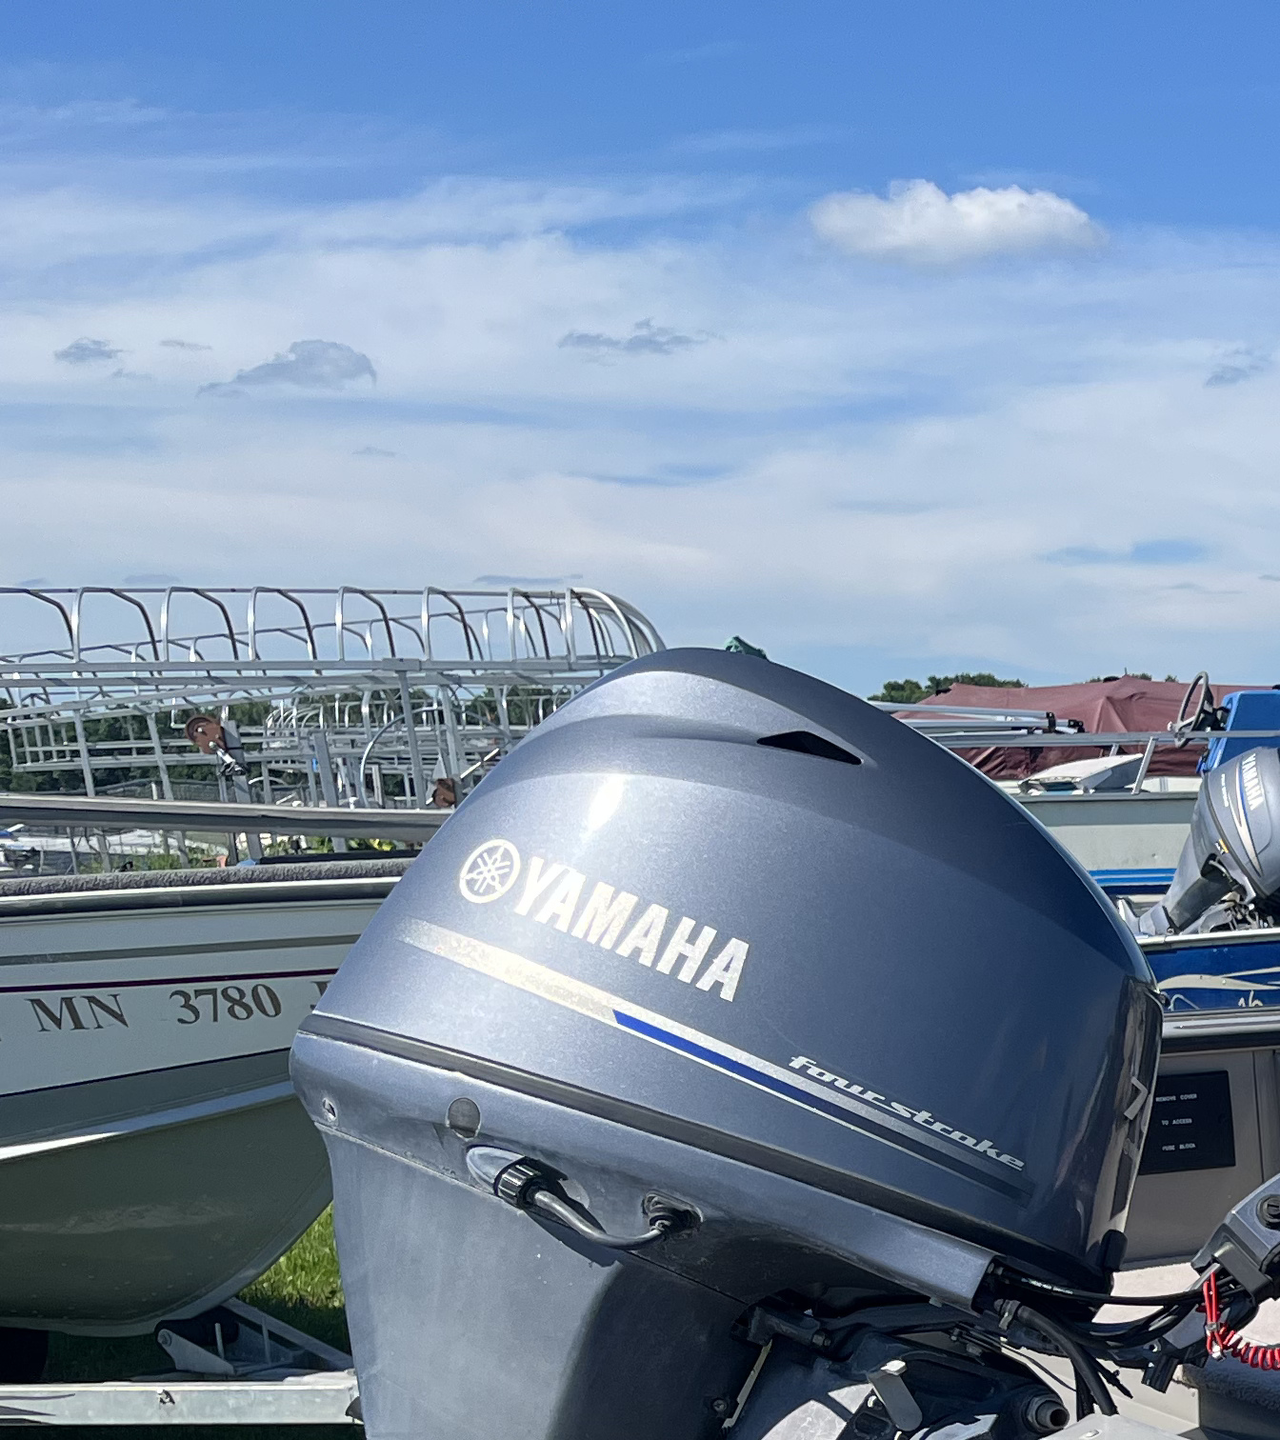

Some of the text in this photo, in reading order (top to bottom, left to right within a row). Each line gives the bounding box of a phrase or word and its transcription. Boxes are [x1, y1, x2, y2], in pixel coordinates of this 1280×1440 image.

[1242, 752, 1265, 811] YAMAHA
[513, 855, 750, 1003] YAMAHA
[25, 993, 130, 1033] MN
[169, 983, 282, 1025] 3780
